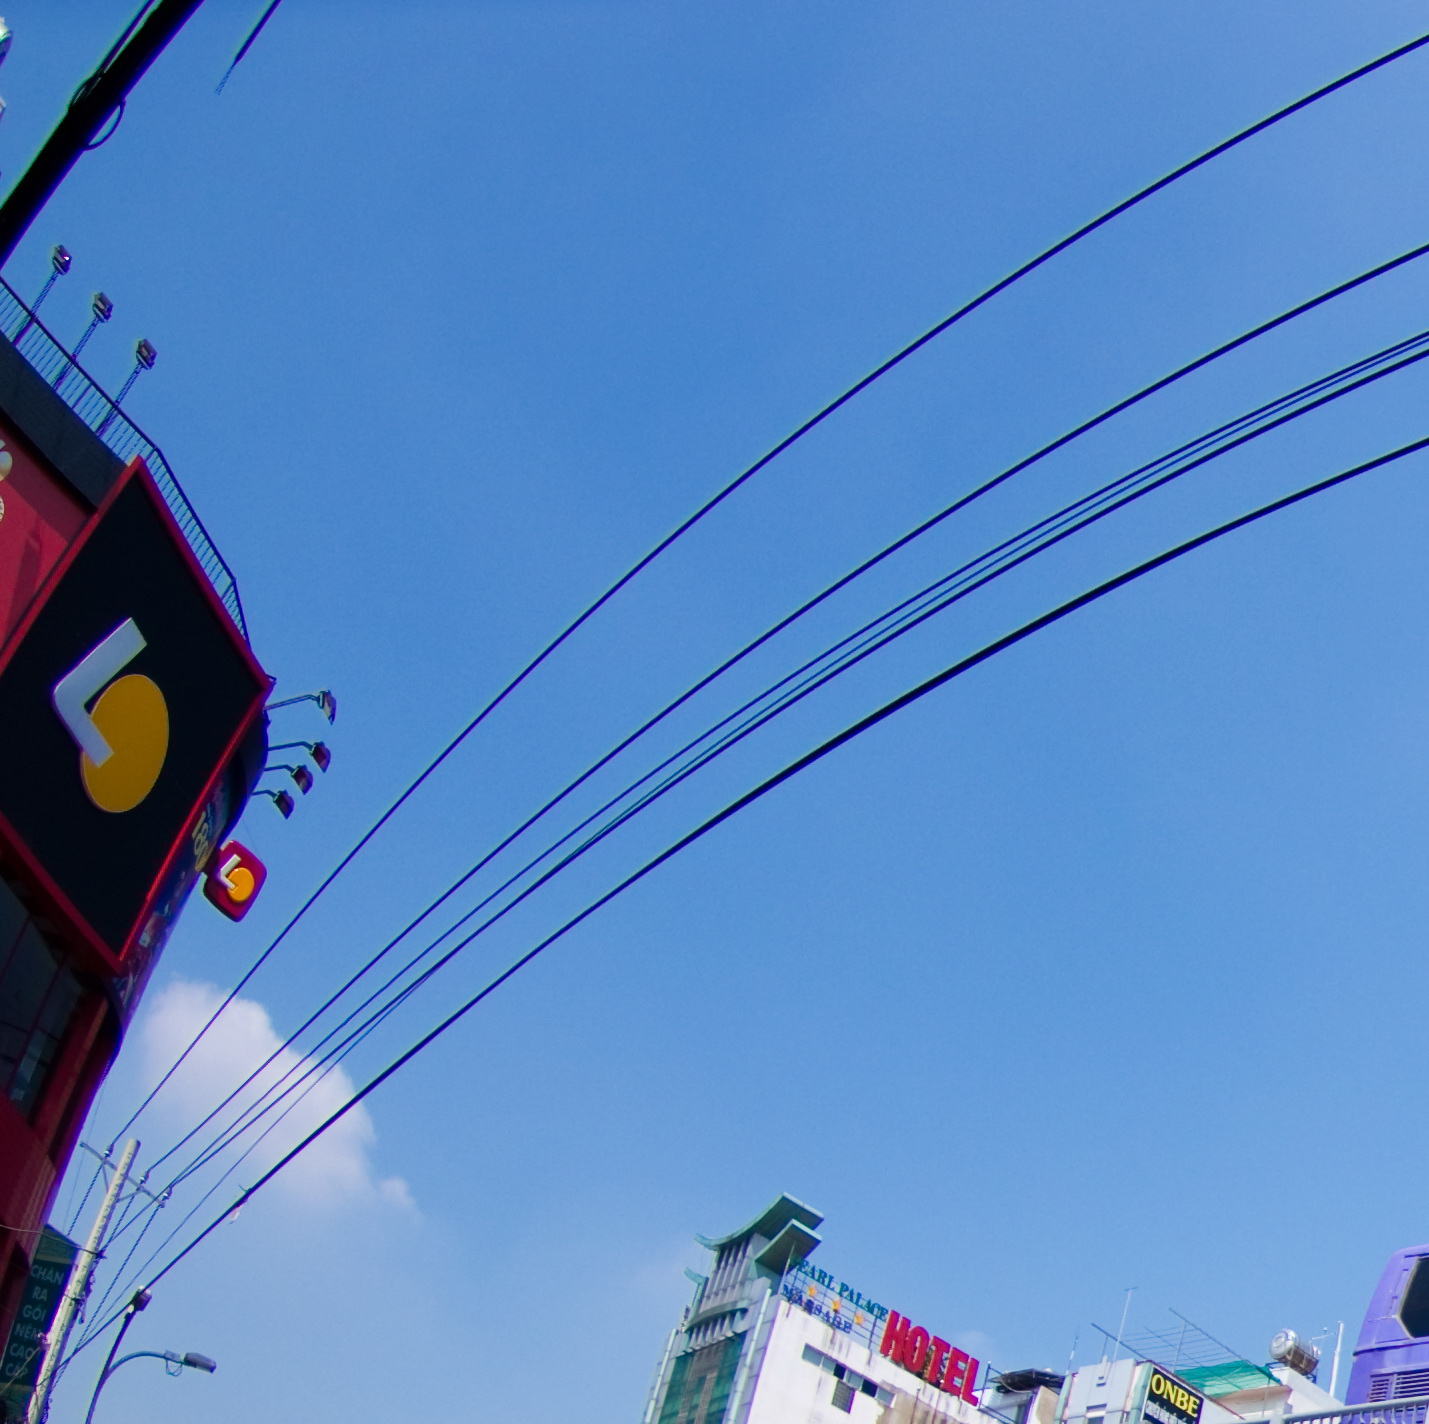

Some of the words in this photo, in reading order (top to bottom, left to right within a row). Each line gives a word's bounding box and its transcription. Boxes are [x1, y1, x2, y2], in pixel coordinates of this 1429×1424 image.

[839, 1281, 889, 1323] PALACE
[880, 1309, 980, 1407] HOTEL
[1151, 1374, 1200, 1418] ONBE
